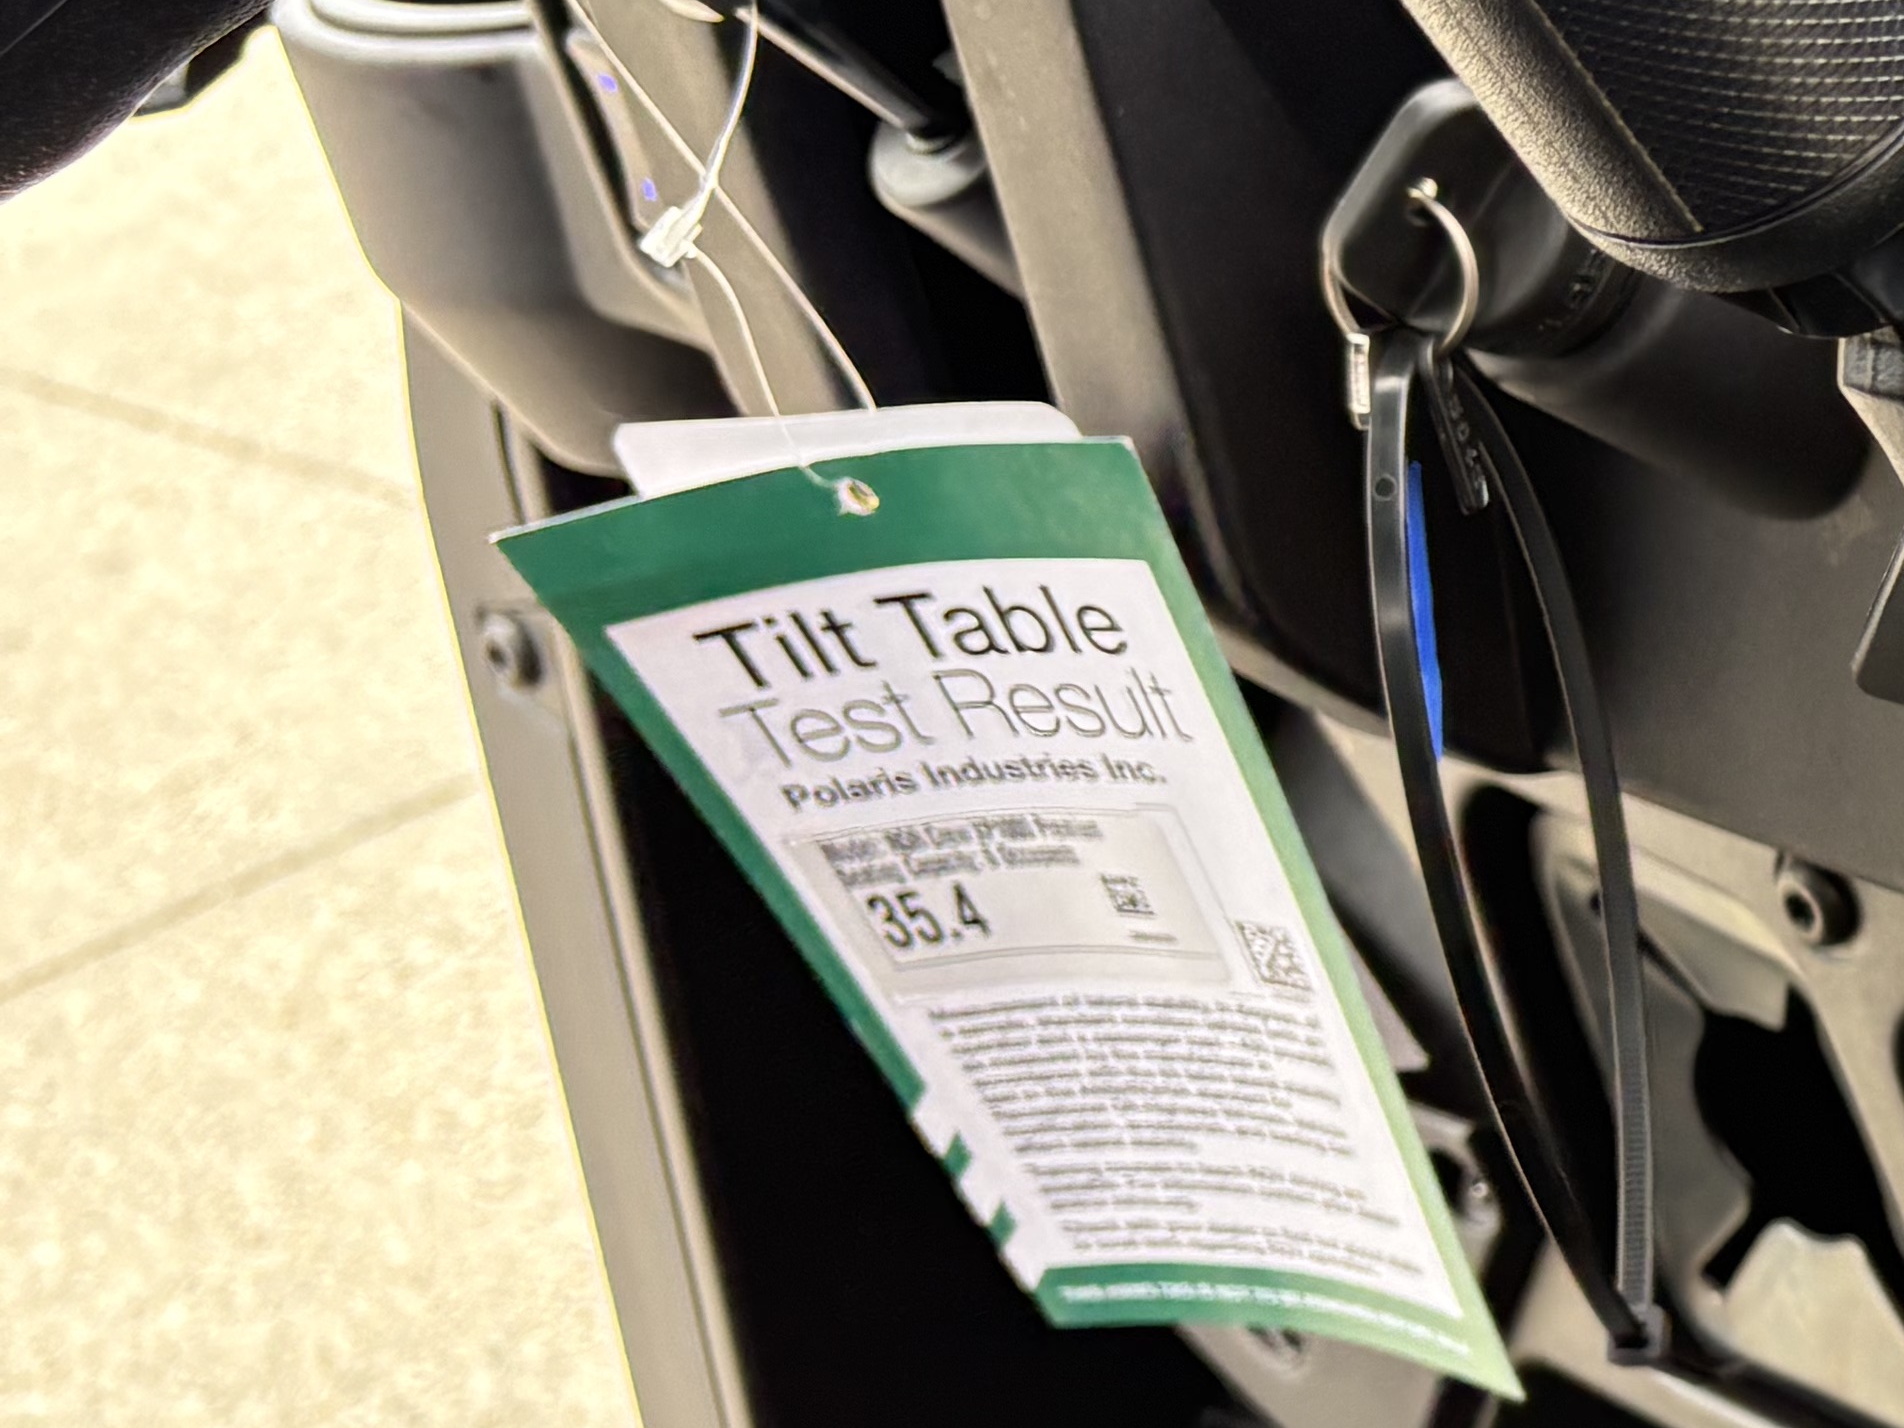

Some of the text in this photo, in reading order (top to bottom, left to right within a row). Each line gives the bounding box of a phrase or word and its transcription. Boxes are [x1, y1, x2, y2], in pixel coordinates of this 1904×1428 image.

[693, 583, 1128, 689] Tilt Table
[718, 667, 1196, 769] Test Result
[782, 752, 1168, 811] Polaris Industries Inc.
[867, 881, 993, 950] 35.4
